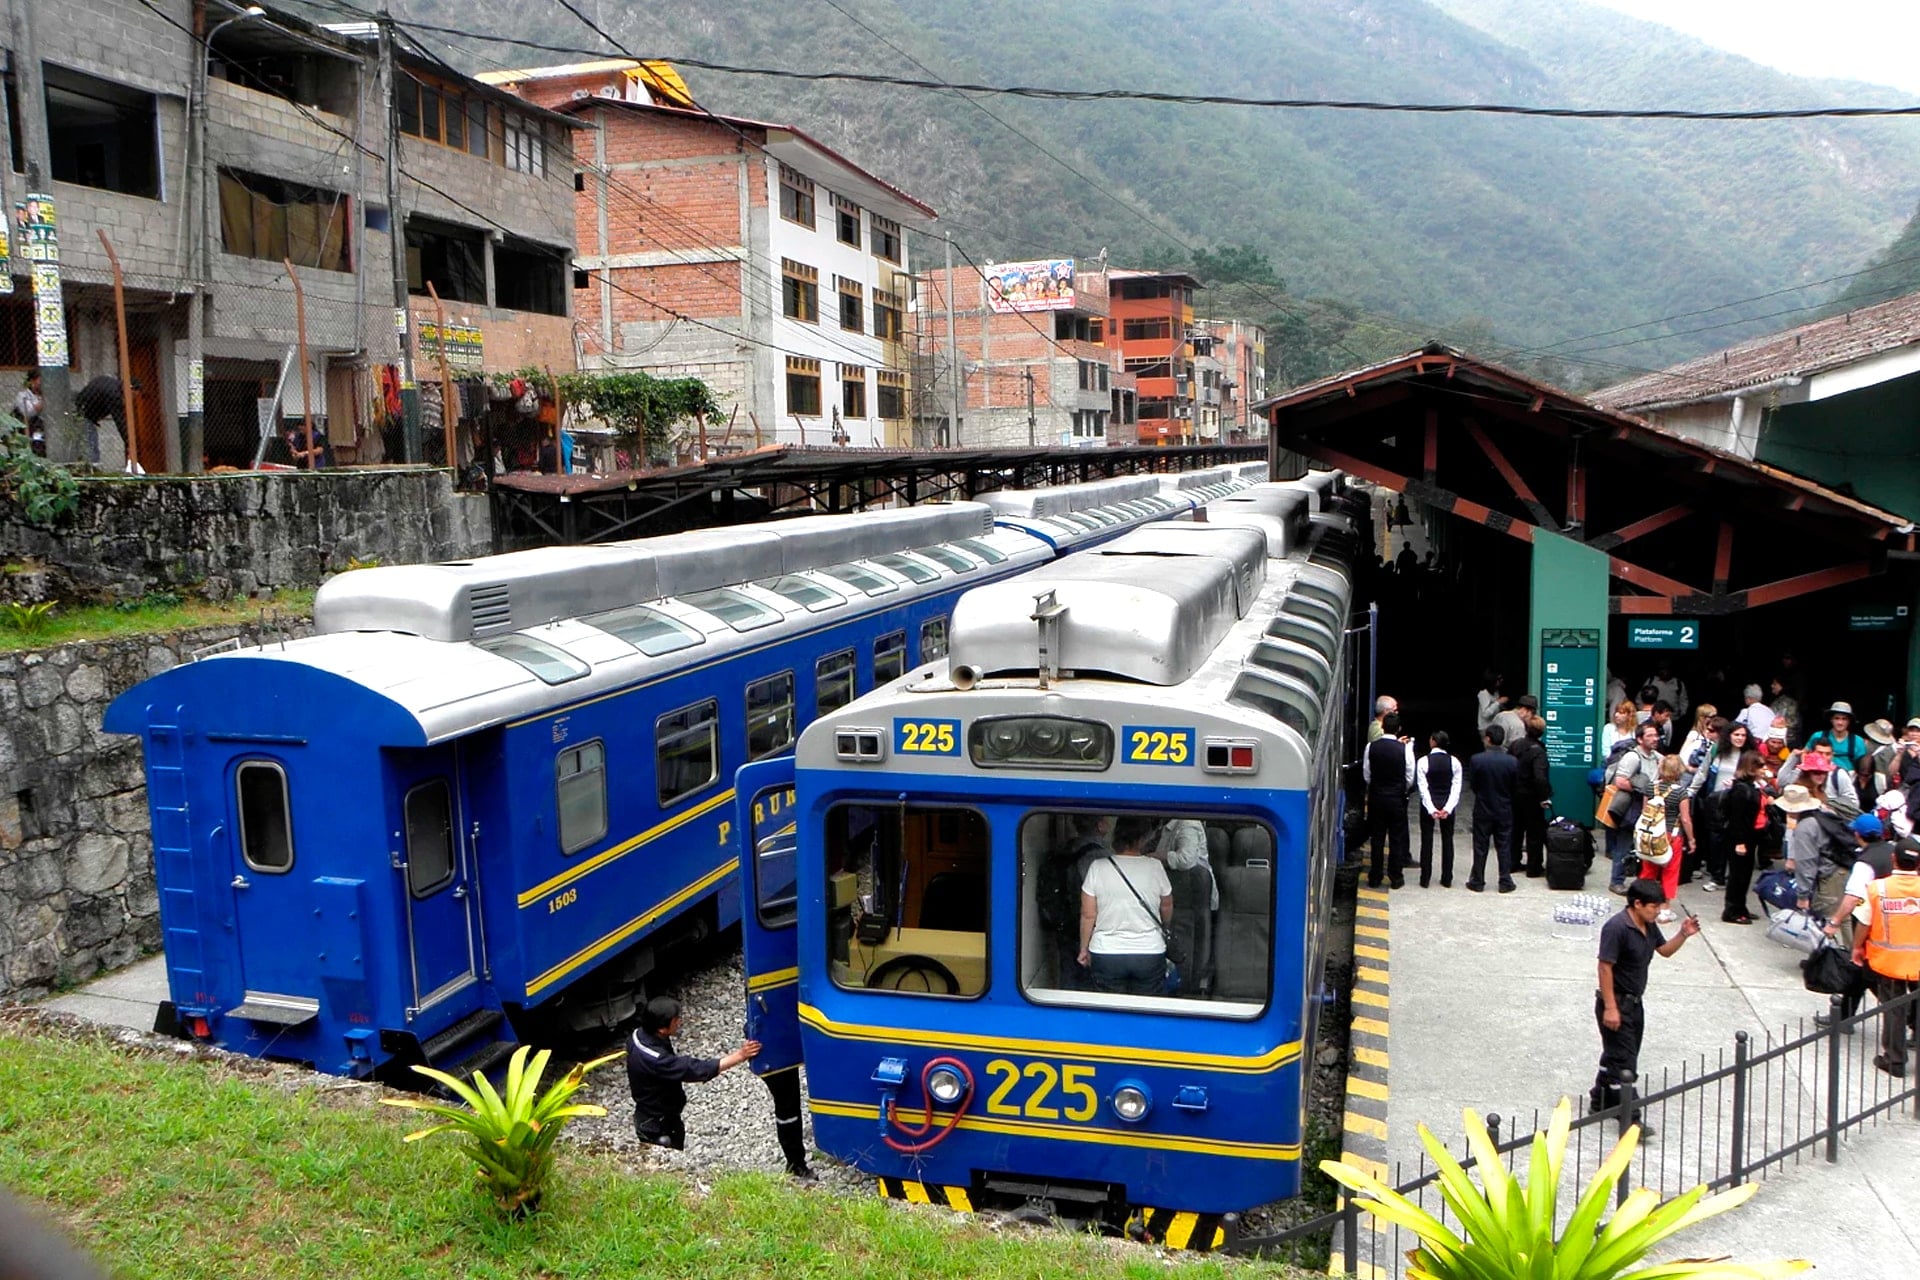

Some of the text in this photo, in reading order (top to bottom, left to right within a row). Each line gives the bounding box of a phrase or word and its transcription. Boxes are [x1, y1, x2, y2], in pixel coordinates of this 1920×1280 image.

[1634, 628, 1673, 636] Plataforma
[1679, 626, 1694, 643] 2
[901, 723, 955, 753] 225
[1131, 731, 1188, 763] 225
[548, 888, 577, 914] 1503
[985, 1058, 1099, 1122] 225
